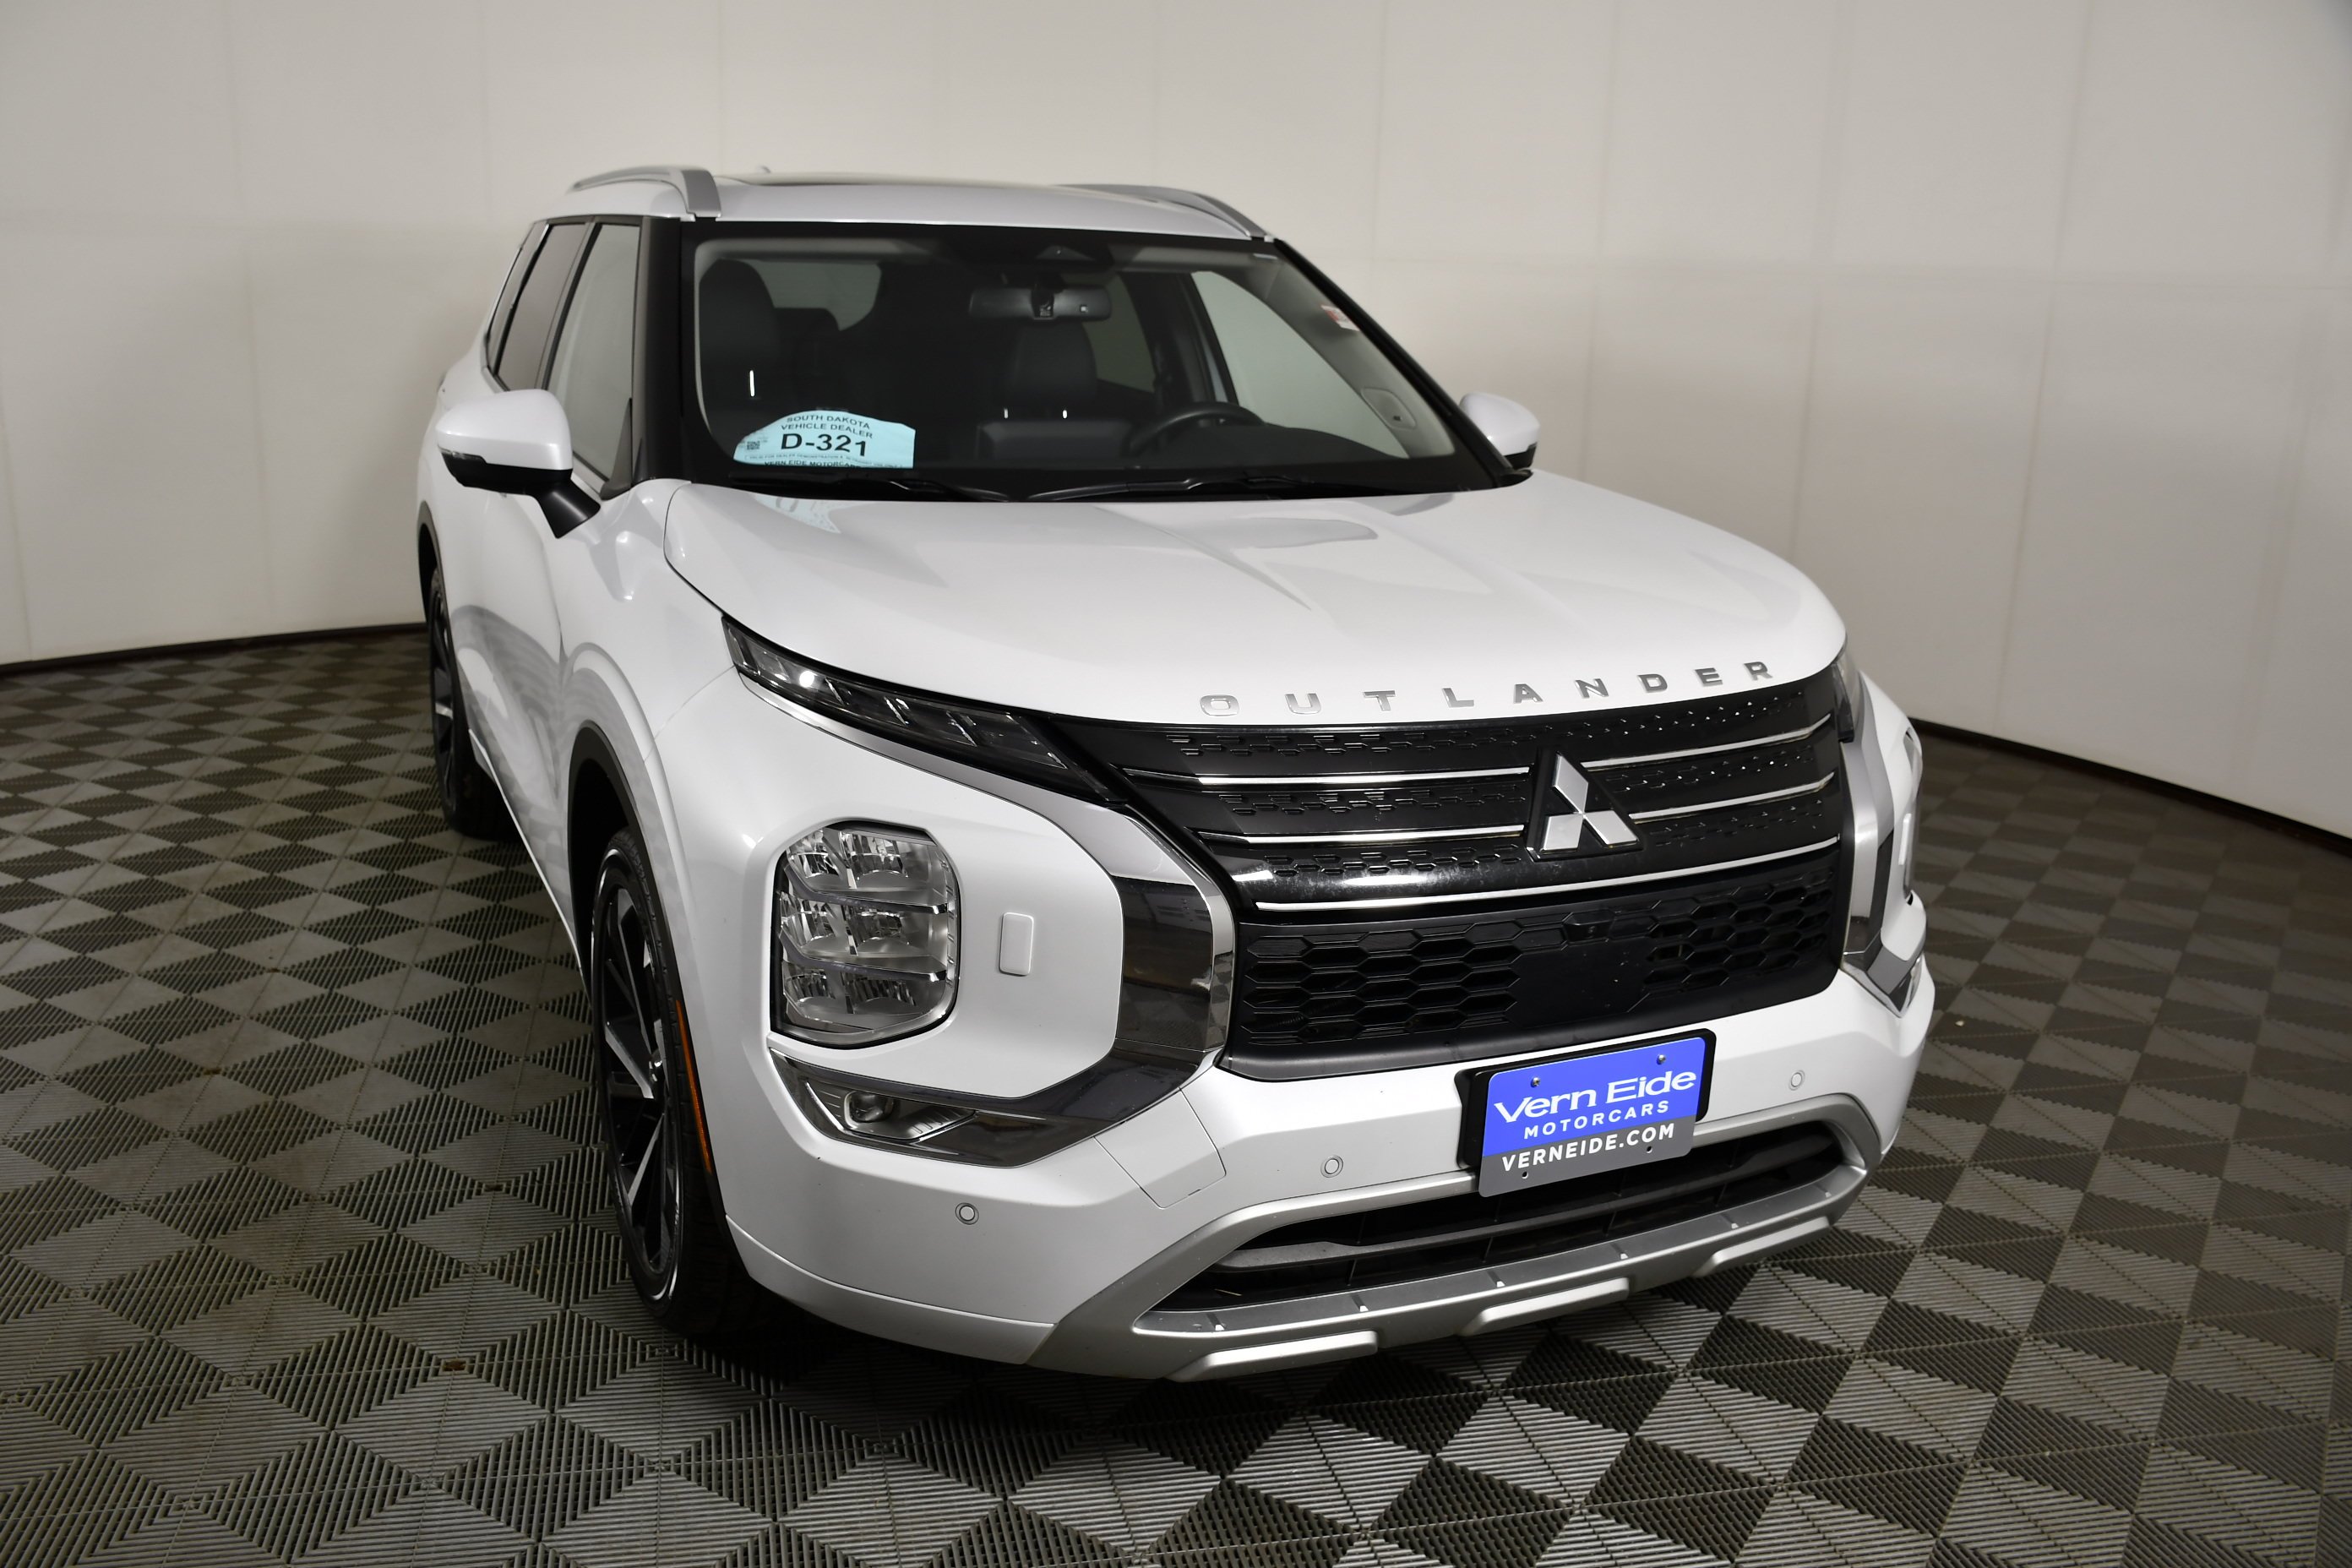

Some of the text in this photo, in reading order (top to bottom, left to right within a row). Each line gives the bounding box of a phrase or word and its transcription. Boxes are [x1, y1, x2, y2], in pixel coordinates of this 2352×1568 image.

[787, 414, 870, 429] SOUTH DAKOTA
[830, 424, 873, 438] DEALER
[781, 433, 866, 456] D-321
[1200, 661, 1773, 717] OUTLANDER
[1494, 1070, 1696, 1123] Vern Eide
[1523, 1100, 1669, 1140] MOTORCARS
[1501, 1123, 1675, 1172] VERNEIDE.COM
